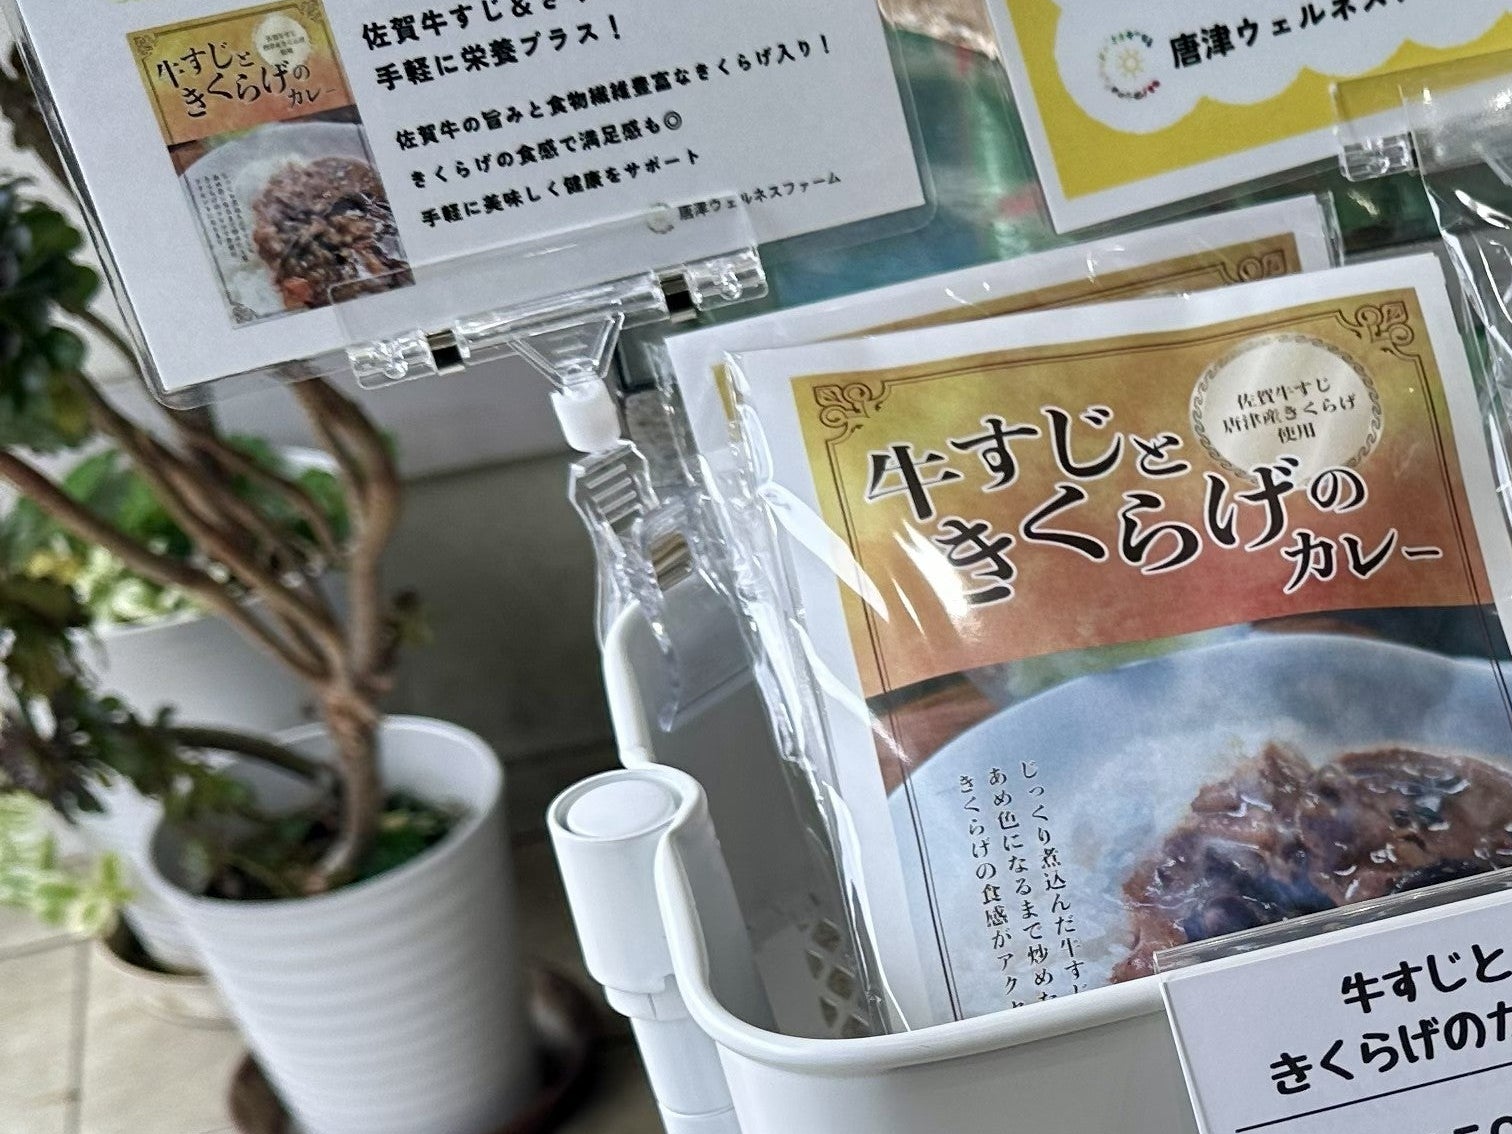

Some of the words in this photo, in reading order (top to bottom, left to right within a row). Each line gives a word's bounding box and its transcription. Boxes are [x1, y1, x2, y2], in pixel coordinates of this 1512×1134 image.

[362, 0, 586, 50] 佐賀牛すじ&
[375, 14, 620, 91] 手軽に栄養プラス！
[1169, 0, 1400, 69] 唐津ウェルネ
[157, 42, 254, 88] 牛すじと
[288, 88, 336, 107] カレー
[421, 148, 699, 228] 手軽に美味しく健康をサポート
[1237, 378, 1330, 410] 佐賀牛すじ
[868, 408, 1190, 520] 牛すじと
[1278, 422, 1316, 443] 使用
[931, 457, 1364, 605] きくらげの
[1283, 527, 1442, 594] カレー
[1341, 944, 1512, 1013] 牛すじと
